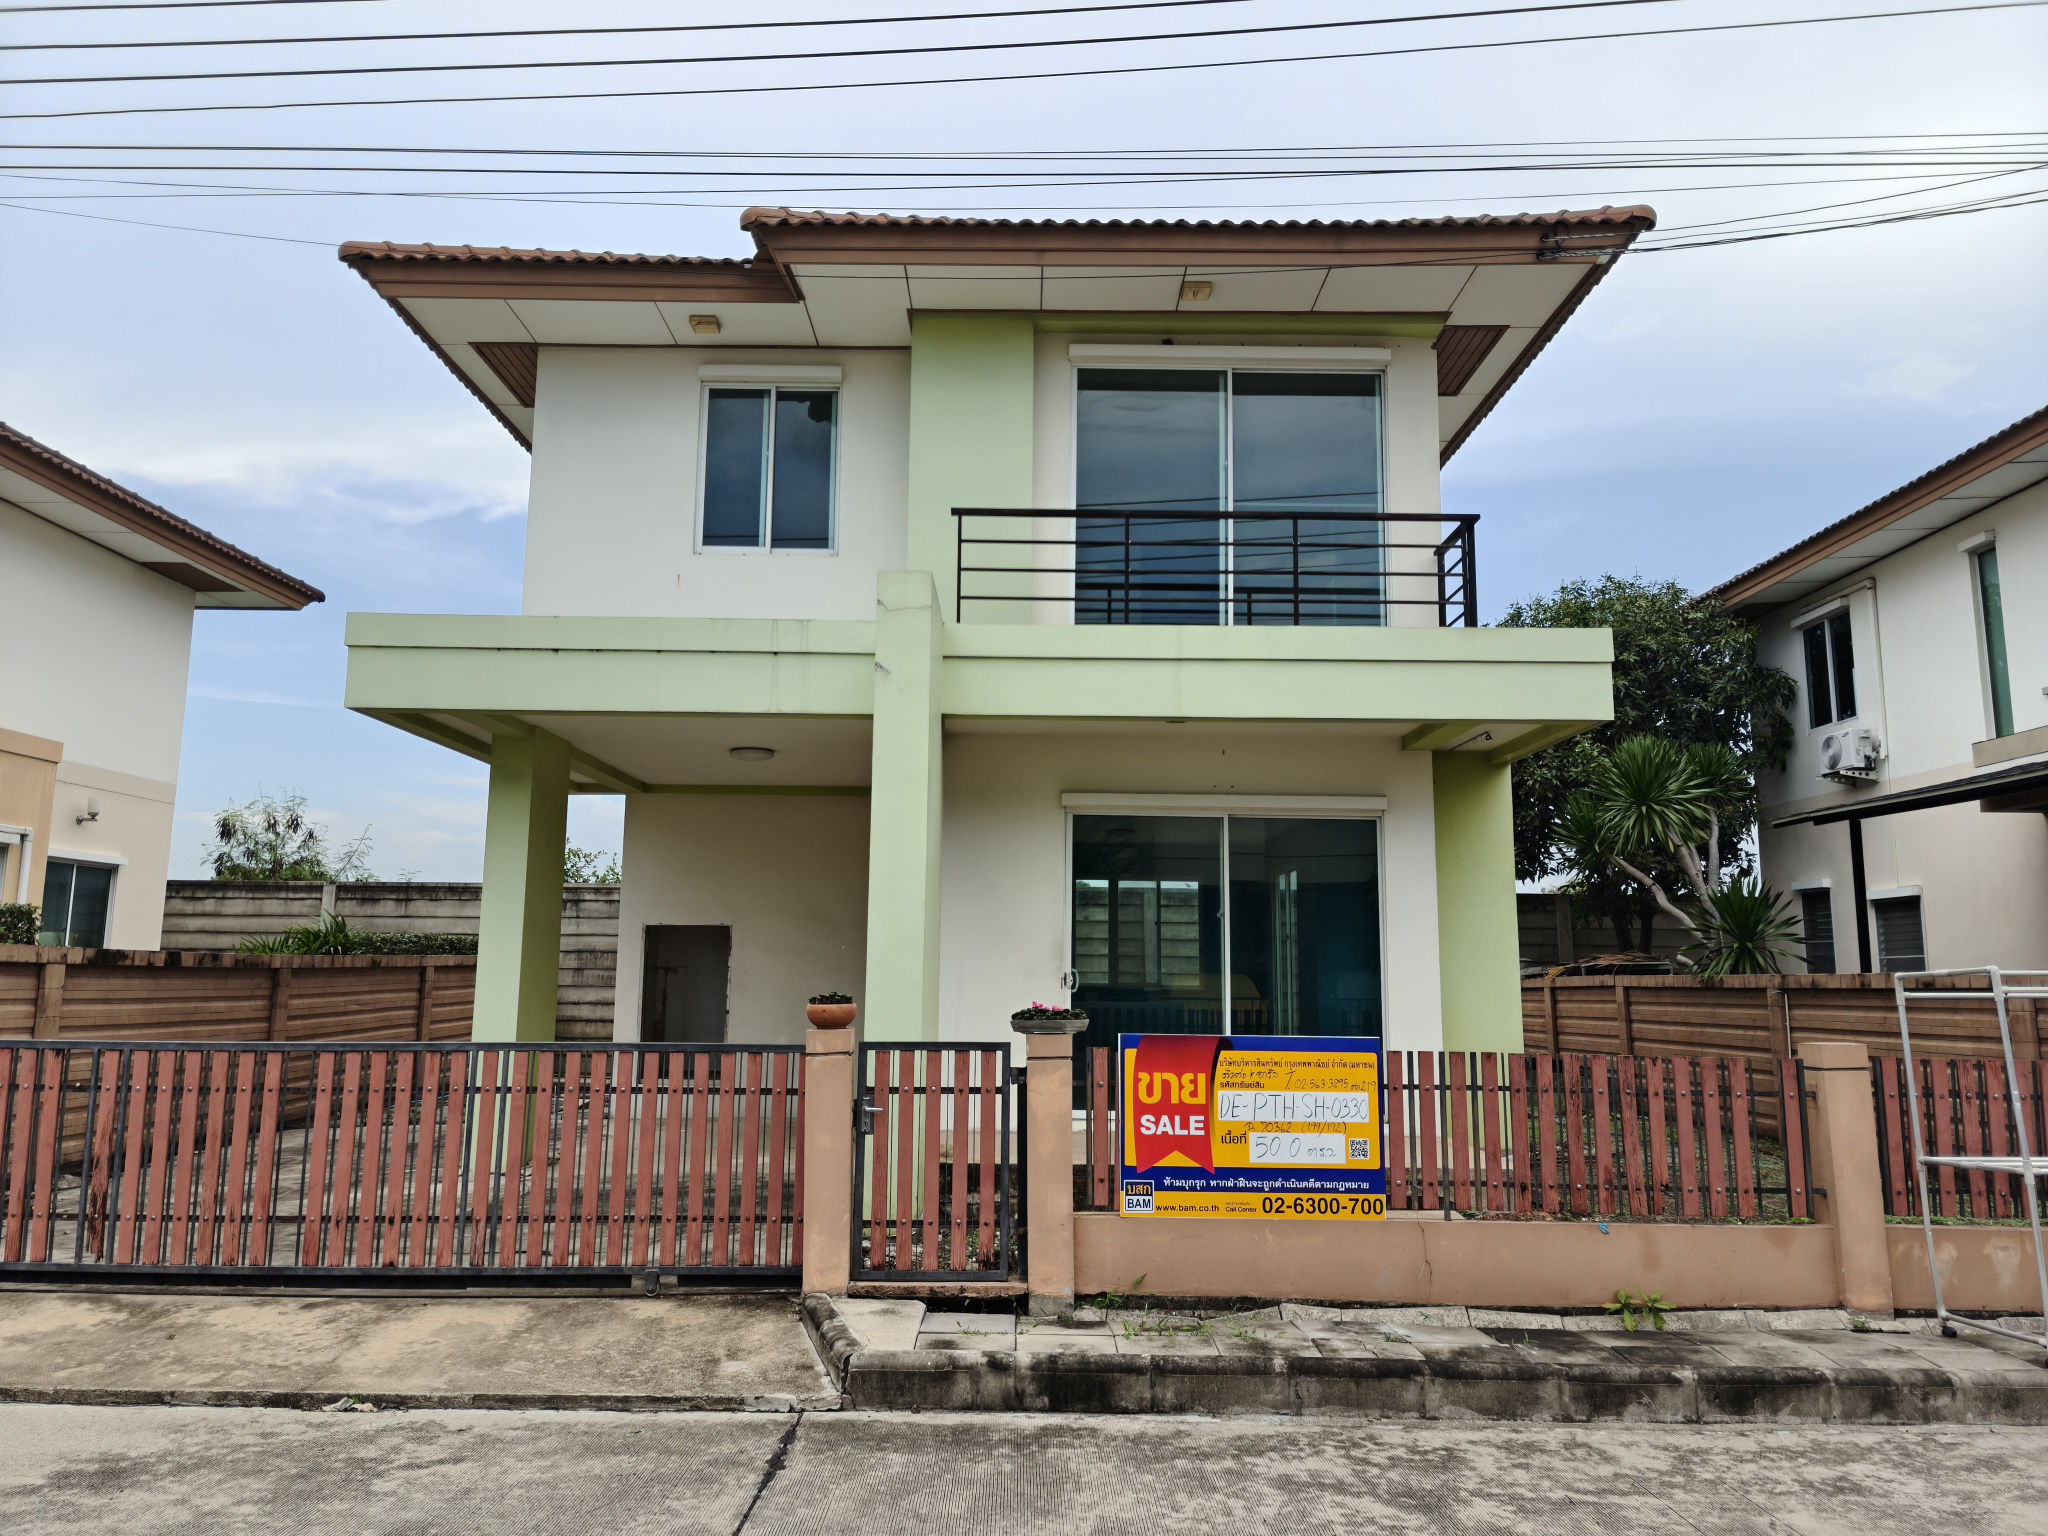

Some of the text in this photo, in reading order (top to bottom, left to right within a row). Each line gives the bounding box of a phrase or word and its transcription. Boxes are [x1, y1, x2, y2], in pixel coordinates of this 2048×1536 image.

[1332, 1060, 1348, 1068] จำกัด
[1138, 1072, 1206, 1105] ขาย
[1220, 1080, 1265, 1089] รหัสทรัพย์สิน
[1140, 1115, 1205, 1136] SALE
[1221, 1130, 1248, 1145] เนื้อที่
[1126, 1184, 1152, 1196] บสก
[1163, 1176, 1370, 1191] ห้ามบุกรุก หากฝ่าฝืนจะถูกดำเนินคดีตามกฎหมาย
[1127, 1197, 1152, 1210] BAM
[1155, 1203, 1220, 1213] www.bam.co.th
[1262, 1196, 1385, 1216] 02-6300-700
